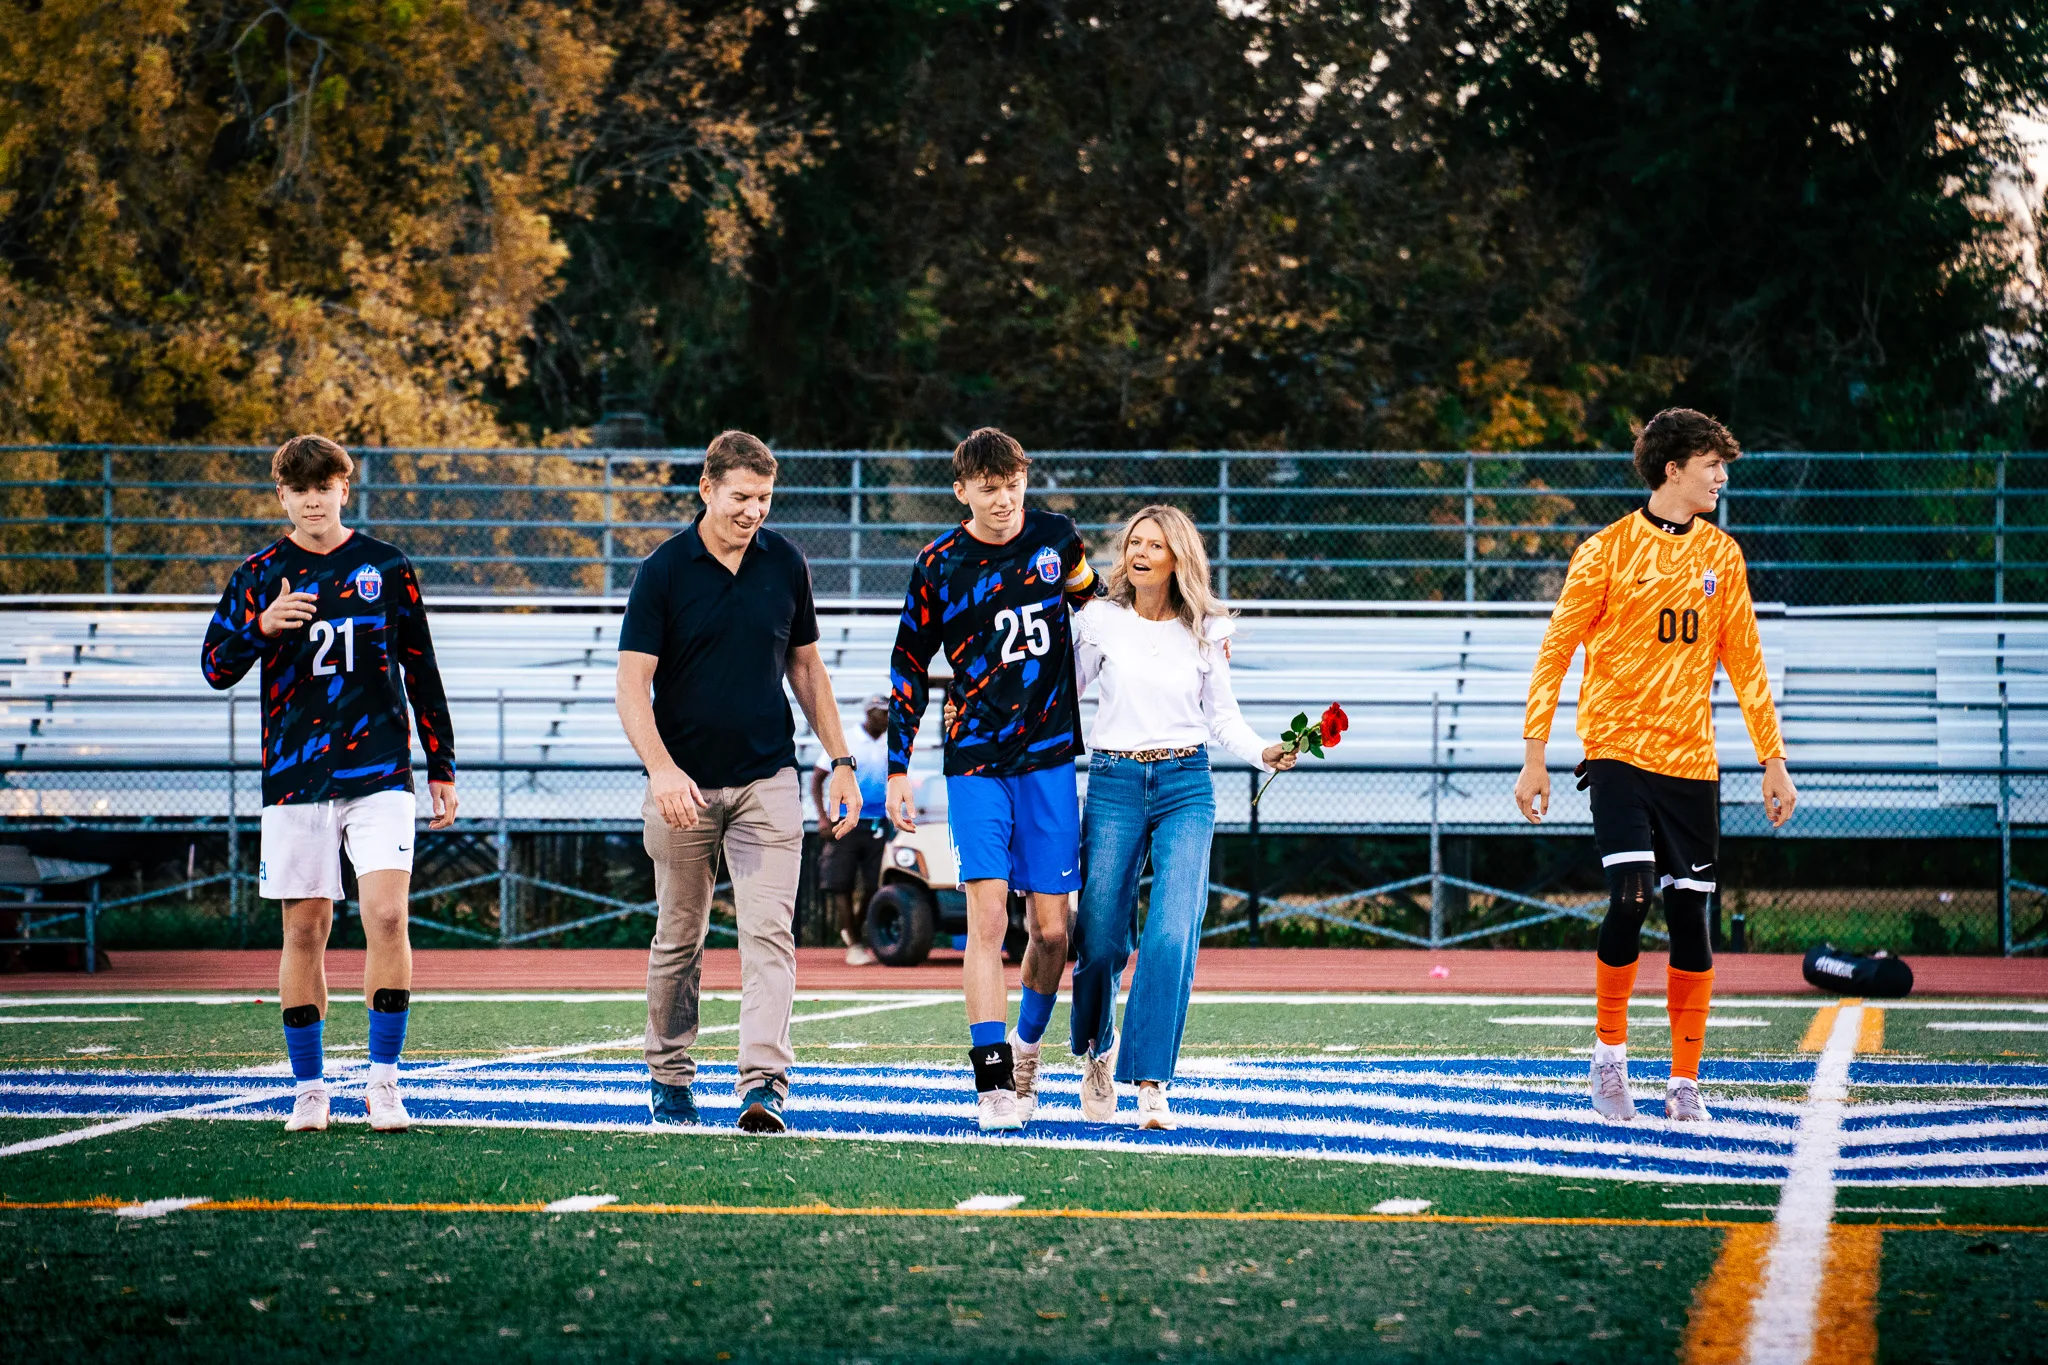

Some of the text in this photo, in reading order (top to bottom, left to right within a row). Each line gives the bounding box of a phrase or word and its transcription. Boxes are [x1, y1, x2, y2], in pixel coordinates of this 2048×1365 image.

[309, 617, 354, 677] 21
[994, 602, 1051, 664] 25
[1658, 607, 1698, 644] 00
